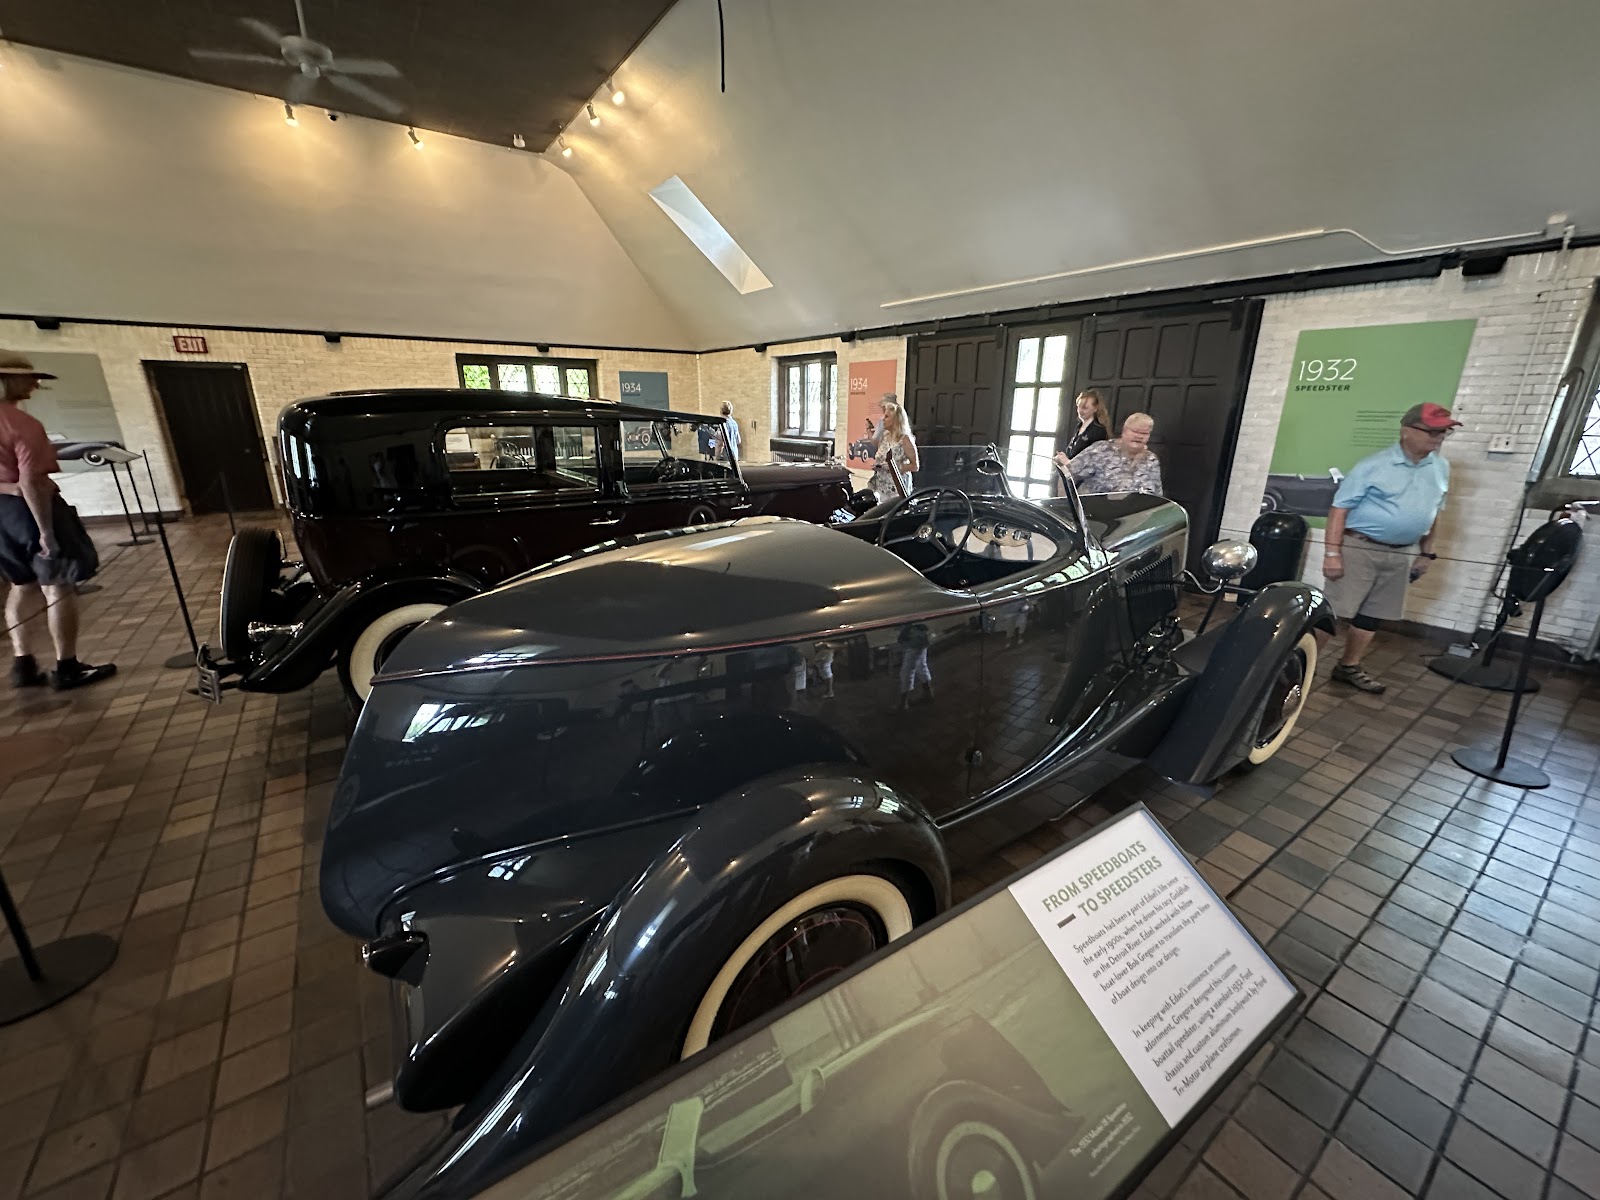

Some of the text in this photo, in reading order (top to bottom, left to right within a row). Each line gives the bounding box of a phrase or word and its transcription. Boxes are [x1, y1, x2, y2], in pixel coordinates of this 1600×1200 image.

[178, 337, 204, 352] EXIT
[1298, 358, 1357, 382] 1932
[622, 382, 642, 392] 1934
[850, 377, 868, 391] 1934
[1295, 384, 1351, 392] SPEEDSTER
[1042, 840, 1147, 912] FROM SPEEDBOATS
[1077, 855, 1162, 917] TO SPEEDSTERS
[1073, 927, 1107, 954] Speedboats
[1105, 920, 1116, 934] had
[1115, 913, 1128, 925] been
[1130, 903, 1140, 916] part
[1139, 897, 1146, 908] of
[1144, 886, 1161, 903] Edsel's
[1083, 954, 1094, 966] the
[1094, 944, 1108, 959] early
[1106, 934, 1125, 950] 1900s,
[1124, 922, 1137, 936] when
[1134, 919, 1143, 928] he
[1142, 909, 1156, 922] drove
[1154, 903, 1162, 913] his
[1161, 897, 1172, 909] racy
[1092, 969, 1102, 979] on
[1100, 960, 1110, 973] the
[1108, 946, 1129, 965] Detroit
[1126, 938, 1143, 953] River.
[1140, 926, 1156, 941] Edsel
[1154, 914, 1172, 931] worked
[1170, 907, 1180, 920] with
[1100, 966, 1129, 992] boat-lover
[1126, 957, 1140, 970] Bob
[1137, 941, 1160, 962] Gregorie
[1158, 938, 1166, 947] to
[1164, 924, 1184, 942] translate
[1182, 916, 1192, 928] the
[1190, 911, 1201, 925] pure
[1112, 946, 1180, 1005] of boat design into car design.
[1132, 1027, 1142, 1038] In
[1138, 1011, 1164, 1034] keeping
[1160, 1000, 1172, 1015] with
[1169, 985, 1188, 1005] Edsel's
[1208, 963, 1214, 972] on
[1144, 1022, 1176, 1053] adornment,
[1172, 1003, 1195, 1025] Gregorie
[1221, 964, 1238, 980] custom
[1152, 1044, 1176, 1068] boattail
[1174, 1023, 1200, 1049] speedster,
[1199, 1008, 1214, 1024] using
[1213, 986, 1233, 1010] standard
[1231, 980, 1244, 995] 1932
[1240, 968, 1254, 984] Ford
[1165, 1062, 1184, 1082] chassis
[1183, 1051, 1194, 1064] and
[1192, 1034, 1211, 1054] custom
[1249, 986, 1259, 998] by
[1254, 975, 1268, 990] Ford
[1173, 1068, 1200, 1096] Tri-Motor
[1199, 1050, 1220, 1073] airplane
